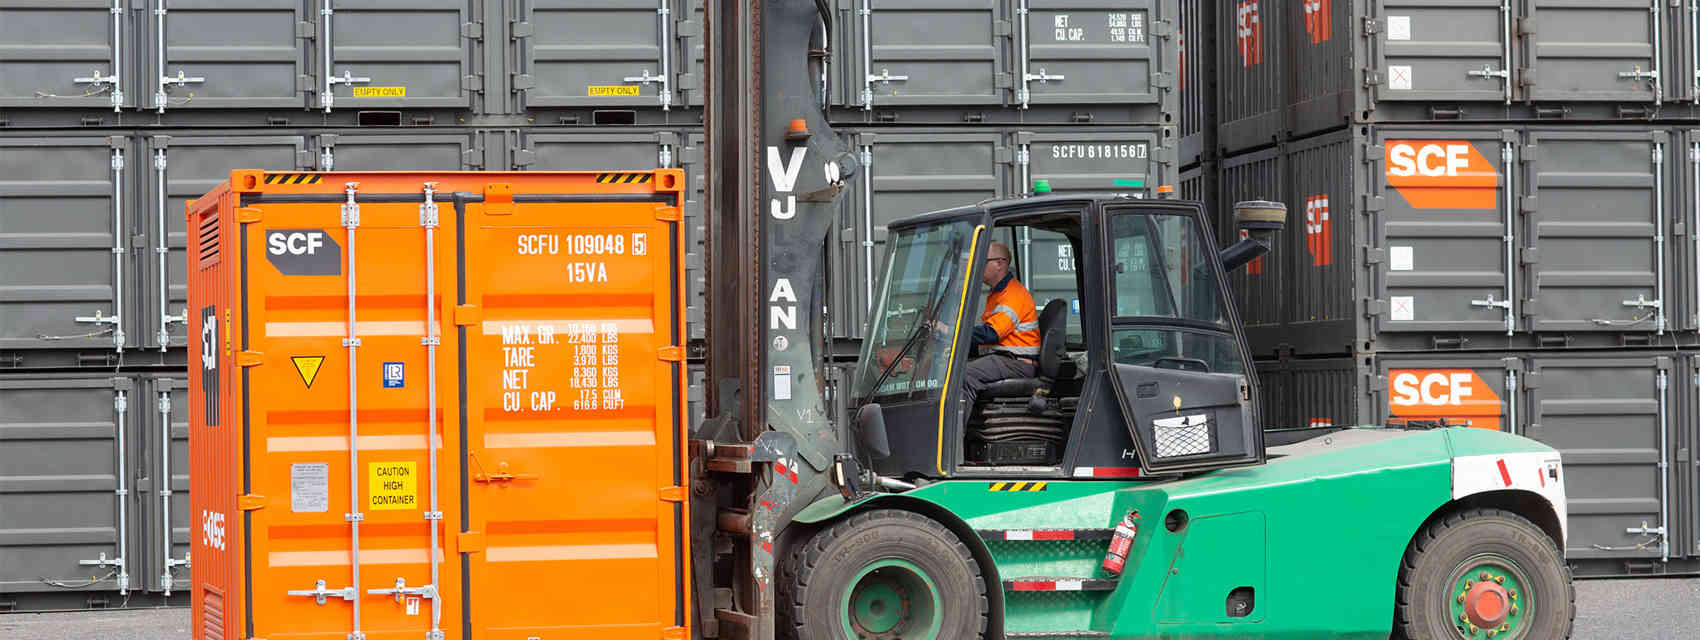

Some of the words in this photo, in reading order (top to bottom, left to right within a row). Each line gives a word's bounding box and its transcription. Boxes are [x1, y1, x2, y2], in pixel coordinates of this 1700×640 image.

[1055, 15, 1069, 27] NET
[1056, 28, 1067, 41] CU.
[1068, 28, 1085, 41] CAP.
[355, 87, 380, 97] EMPTY
[382, 87, 405, 97] ONLY
[589, 87, 615, 97] EMPTY
[616, 87, 638, 97] ONLY
[1052, 144, 1085, 158] SCFU
[1087, 144, 1136, 158] 618156
[1389, 144, 1469, 176] SCF
[268, 232, 323, 255] SCF
[517, 234, 559, 255] SCFU
[565, 234, 625, 255] 109048
[632, 232, 647, 256] 5
[566, 262, 608, 283] 15VA
[502, 324, 536, 345] MAX.
[537, 325, 560, 345] GR.
[503, 346, 536, 368] TARE
[602, 355, 619, 366] LBS
[602, 366, 619, 377] KGS
[503, 369, 529, 390] NET
[602, 377, 619, 388] LBS
[1393, 373, 1473, 406] SCF
[503, 391, 525, 412] CU.
[531, 391, 561, 412] CAP.
[376, 466, 410, 477] CAUTION
[383, 480, 404, 491] HIGH
[372, 495, 415, 505] CONTAINER
